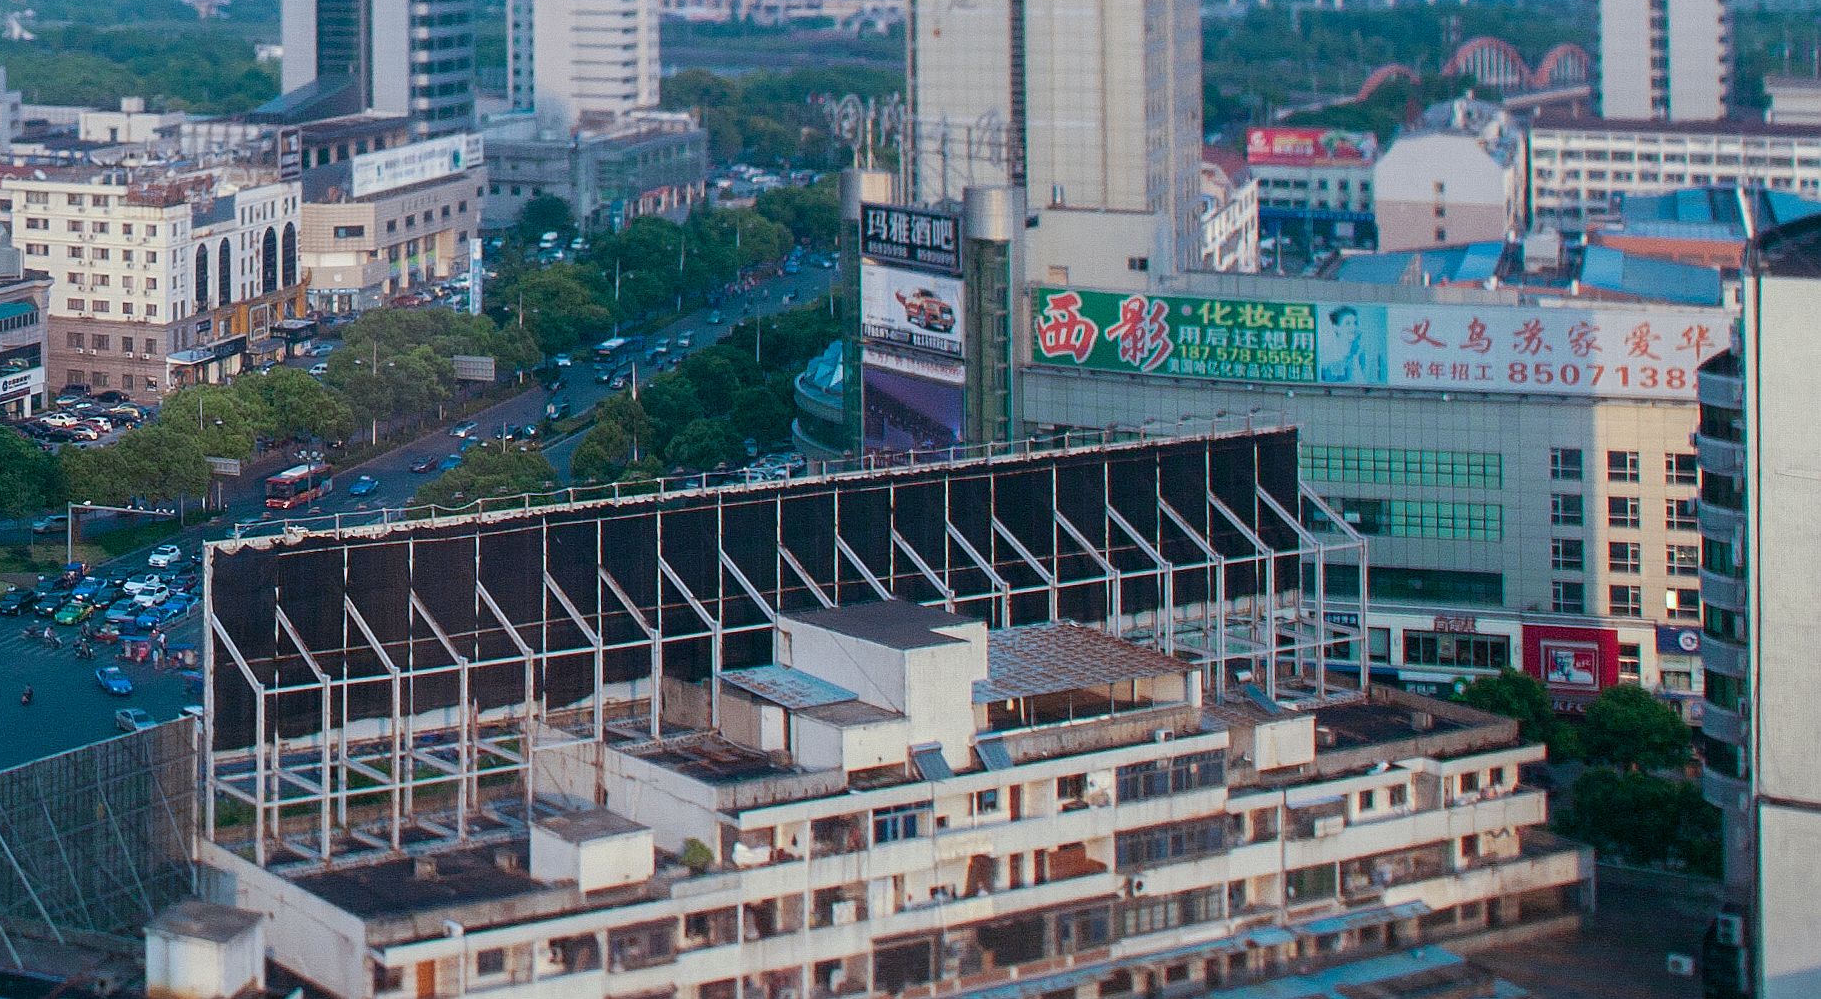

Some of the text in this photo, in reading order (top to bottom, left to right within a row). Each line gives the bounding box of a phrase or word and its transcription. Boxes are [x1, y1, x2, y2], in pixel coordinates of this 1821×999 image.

[867, 209, 955, 250] 玛雅酒吧
[1197, 301, 1315, 329] 化妆品
[1037, 291, 1174, 372] 西影
[1178, 326, 1315, 351] 用后还想用
[1400, 317, 1716, 361] 义乌苏家爱华
[1178, 345, 1210, 360] 187
[1216, 346, 1251, 362] 578
[1403, 360, 1699, 390] 常年招工 8507138
